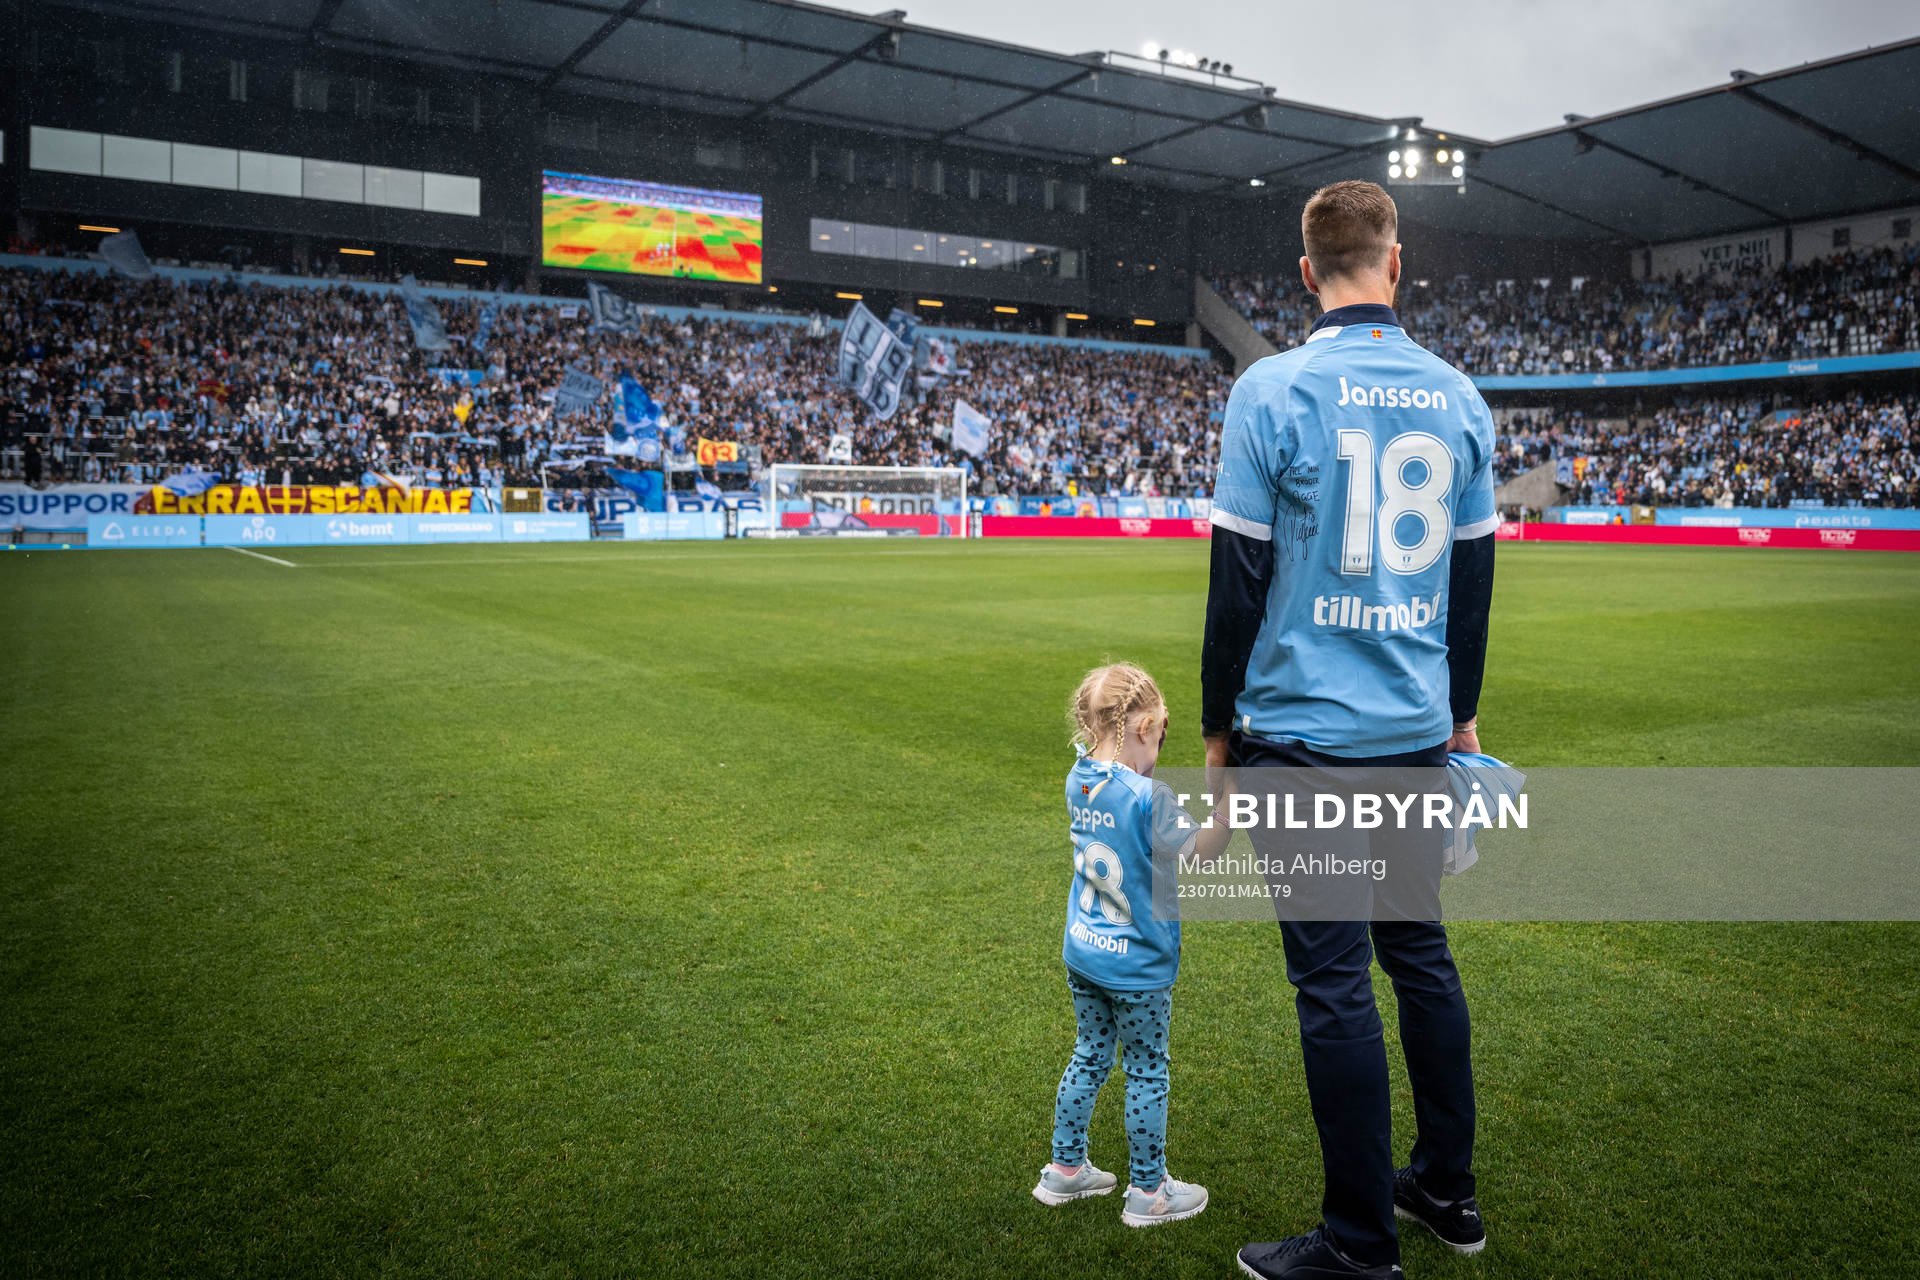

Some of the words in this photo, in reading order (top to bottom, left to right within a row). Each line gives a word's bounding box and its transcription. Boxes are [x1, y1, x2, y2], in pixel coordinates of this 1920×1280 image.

[1337, 376, 1447, 410] Jansson
[309, 486, 473, 514] SCANIAE
[1337, 428, 1454, 577] 18
[132, 526, 187, 536] ELEDA
[350, 522, 393, 536] bemt
[1737, 528, 1771, 539] TICTAC
[1819, 529, 1856, 541] TICTAC
